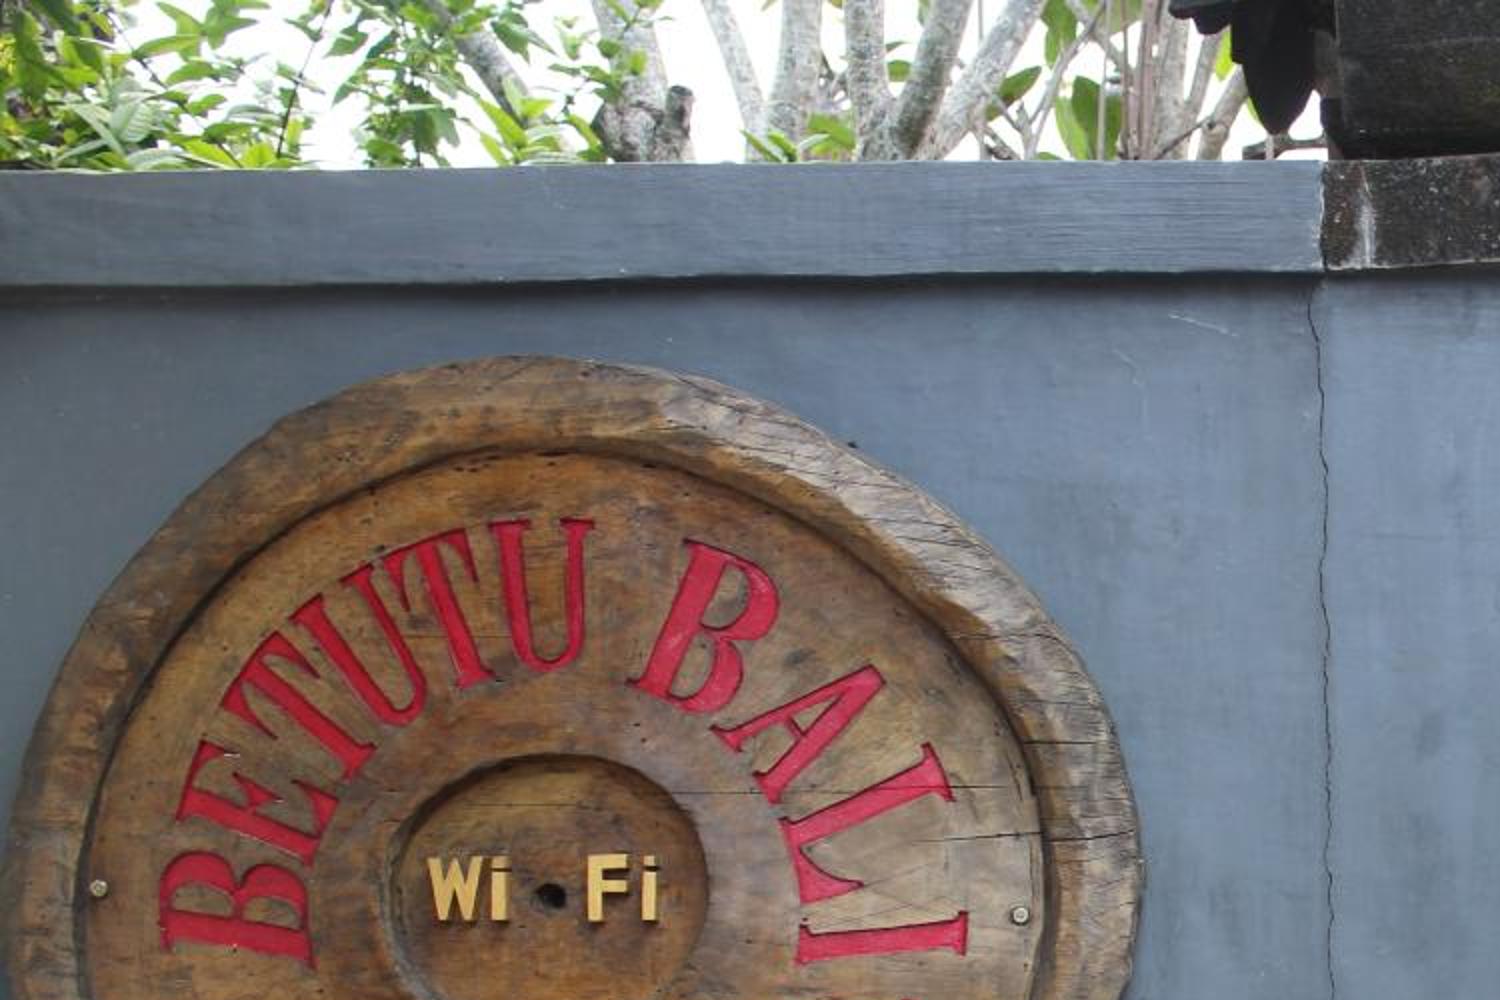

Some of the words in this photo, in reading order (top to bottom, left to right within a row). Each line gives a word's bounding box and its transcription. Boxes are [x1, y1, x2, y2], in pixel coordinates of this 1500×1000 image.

[160, 519, 594, 967] BETUTU
[629, 539, 968, 966] BALI
[426, 855, 509, 923] Wi
[585, 853, 660, 923] Fi
